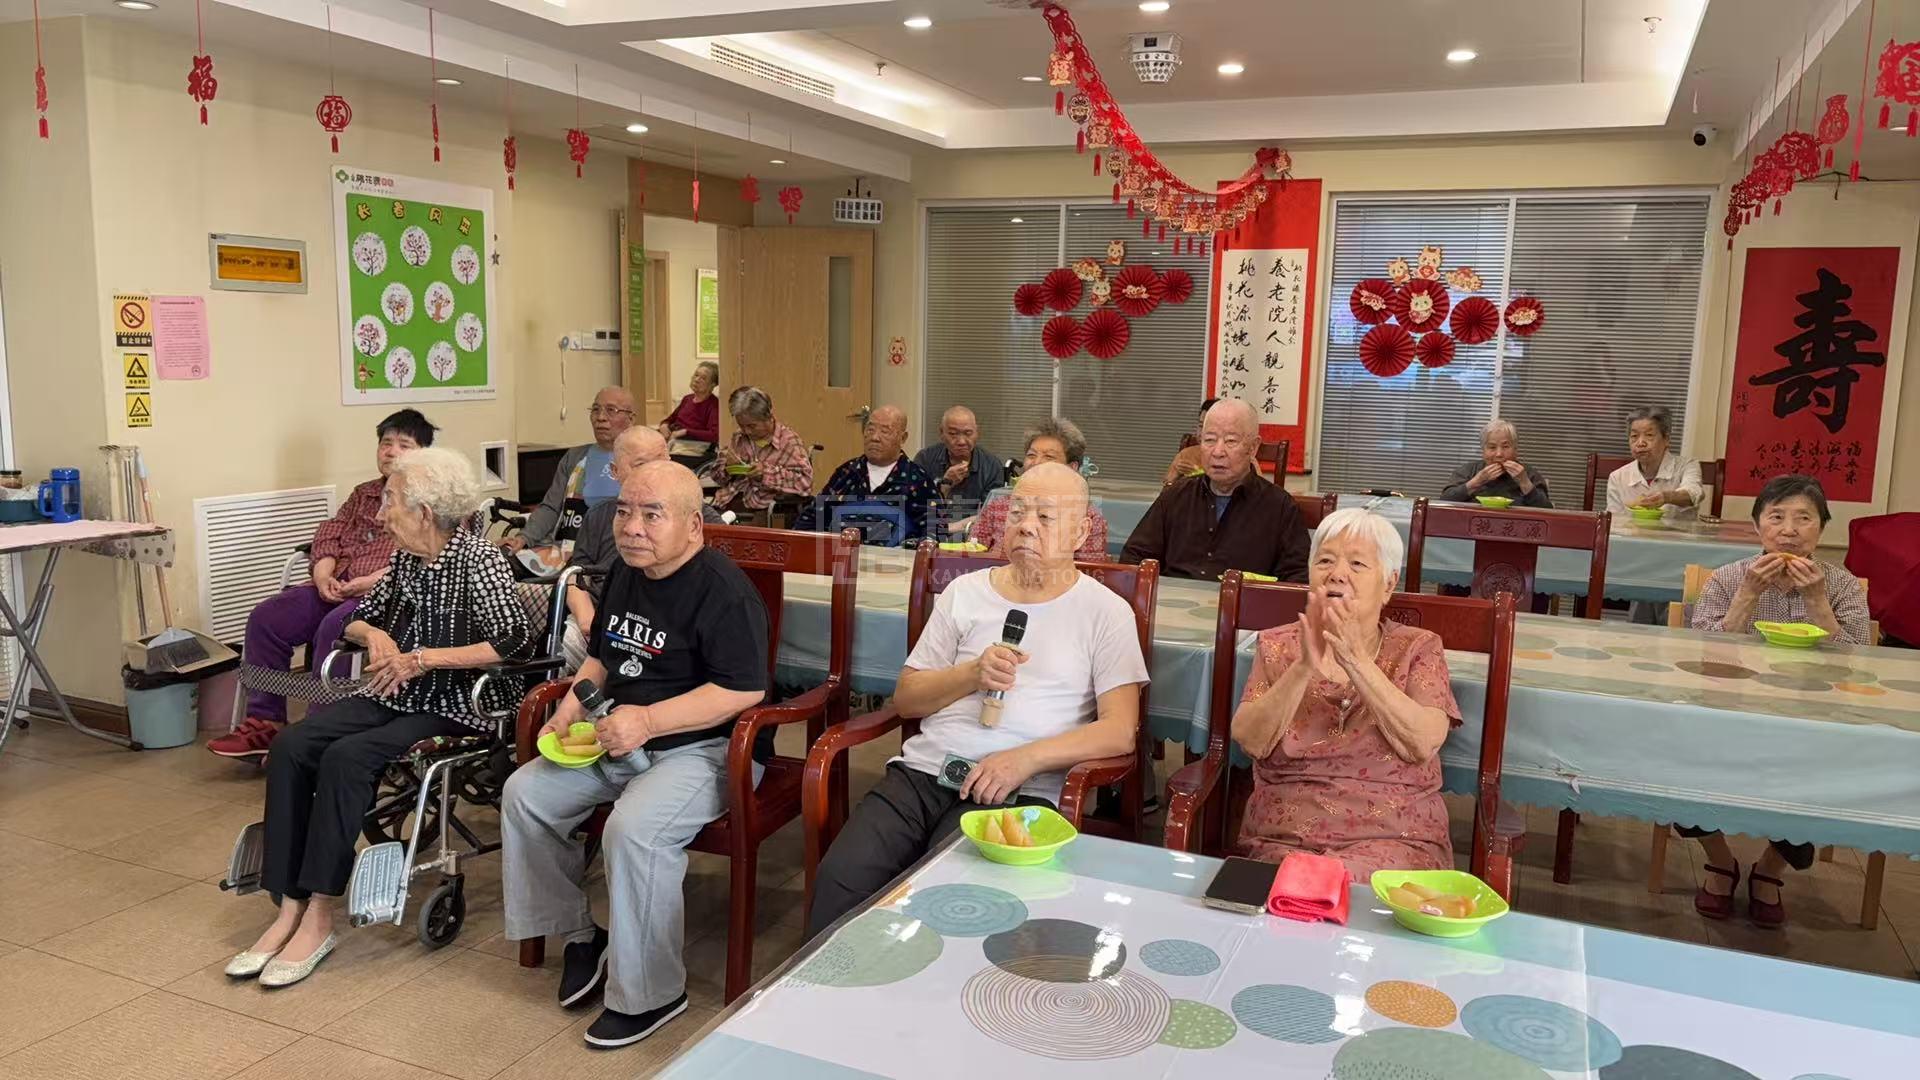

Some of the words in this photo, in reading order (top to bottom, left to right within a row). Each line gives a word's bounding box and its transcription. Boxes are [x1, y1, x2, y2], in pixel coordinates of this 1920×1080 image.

[188, 56, 217, 102] 福
[321, 99, 349, 129] 福
[607, 614, 667, 649] PARIS
